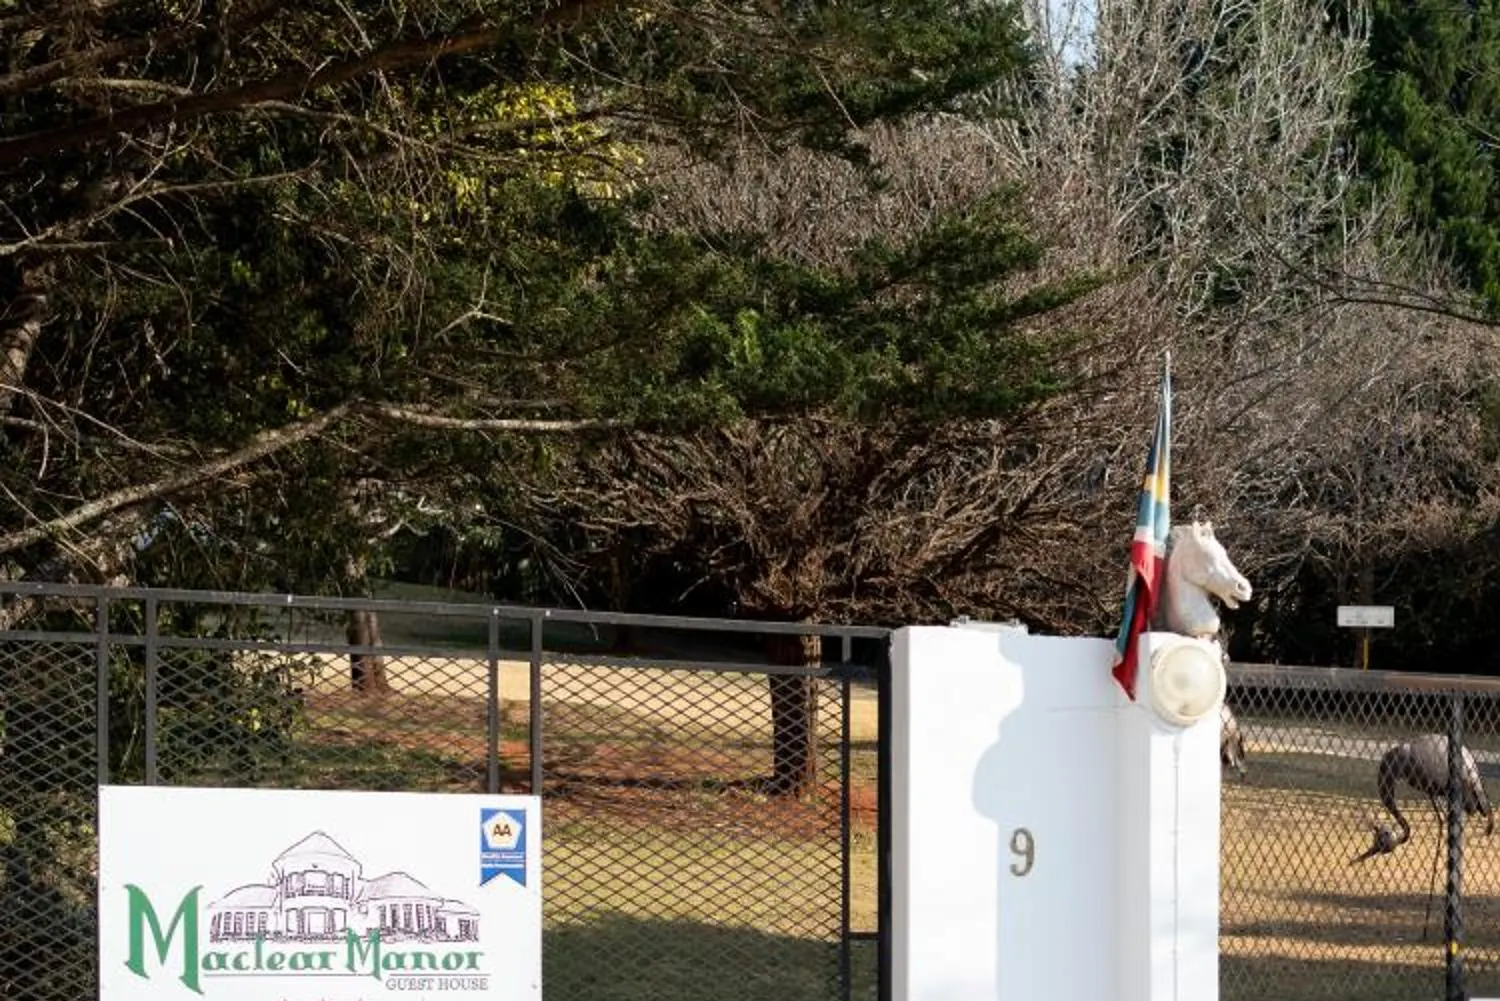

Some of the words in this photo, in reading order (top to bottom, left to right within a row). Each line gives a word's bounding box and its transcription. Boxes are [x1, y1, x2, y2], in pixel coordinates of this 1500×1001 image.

[493, 823, 512, 837] AA
[1009, 827, 1035, 877] 9
[124, 884, 336, 995] Maclear
[346, 928, 485, 981] Manor
[385, 978, 435, 991] GUEST
[439, 977, 489, 990] HOUSE
